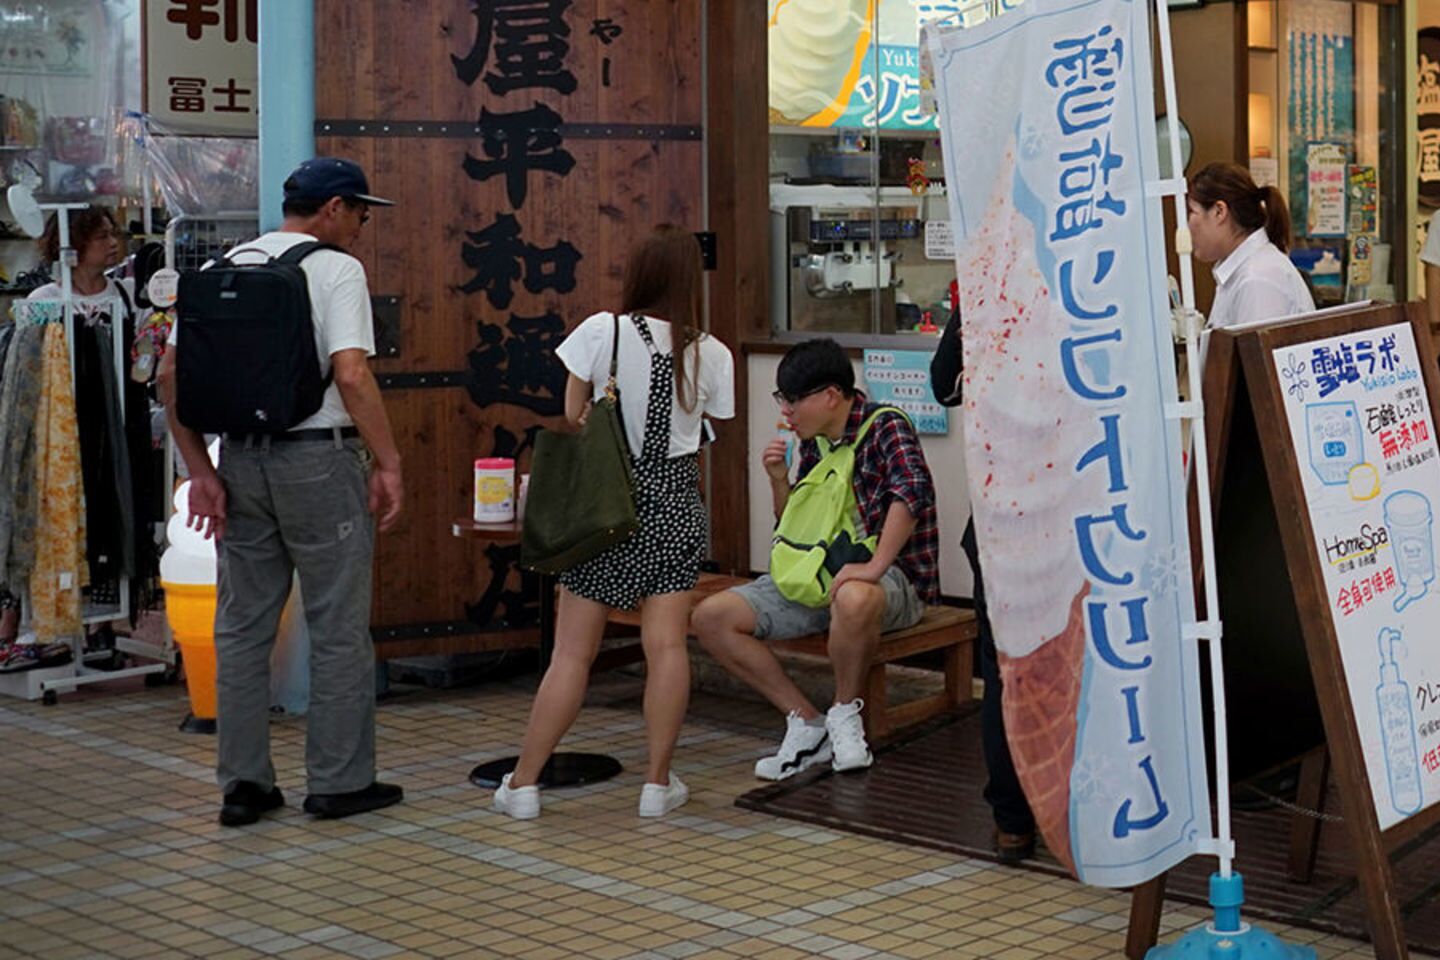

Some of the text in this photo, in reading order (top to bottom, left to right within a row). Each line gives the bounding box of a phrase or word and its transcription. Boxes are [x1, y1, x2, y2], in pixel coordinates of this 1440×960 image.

[1311, 332, 1400, 398] 雪塩ラボ
[1378, 419, 1430, 459] 無添加
[1323, 524, 1388, 563] HomeSpa
